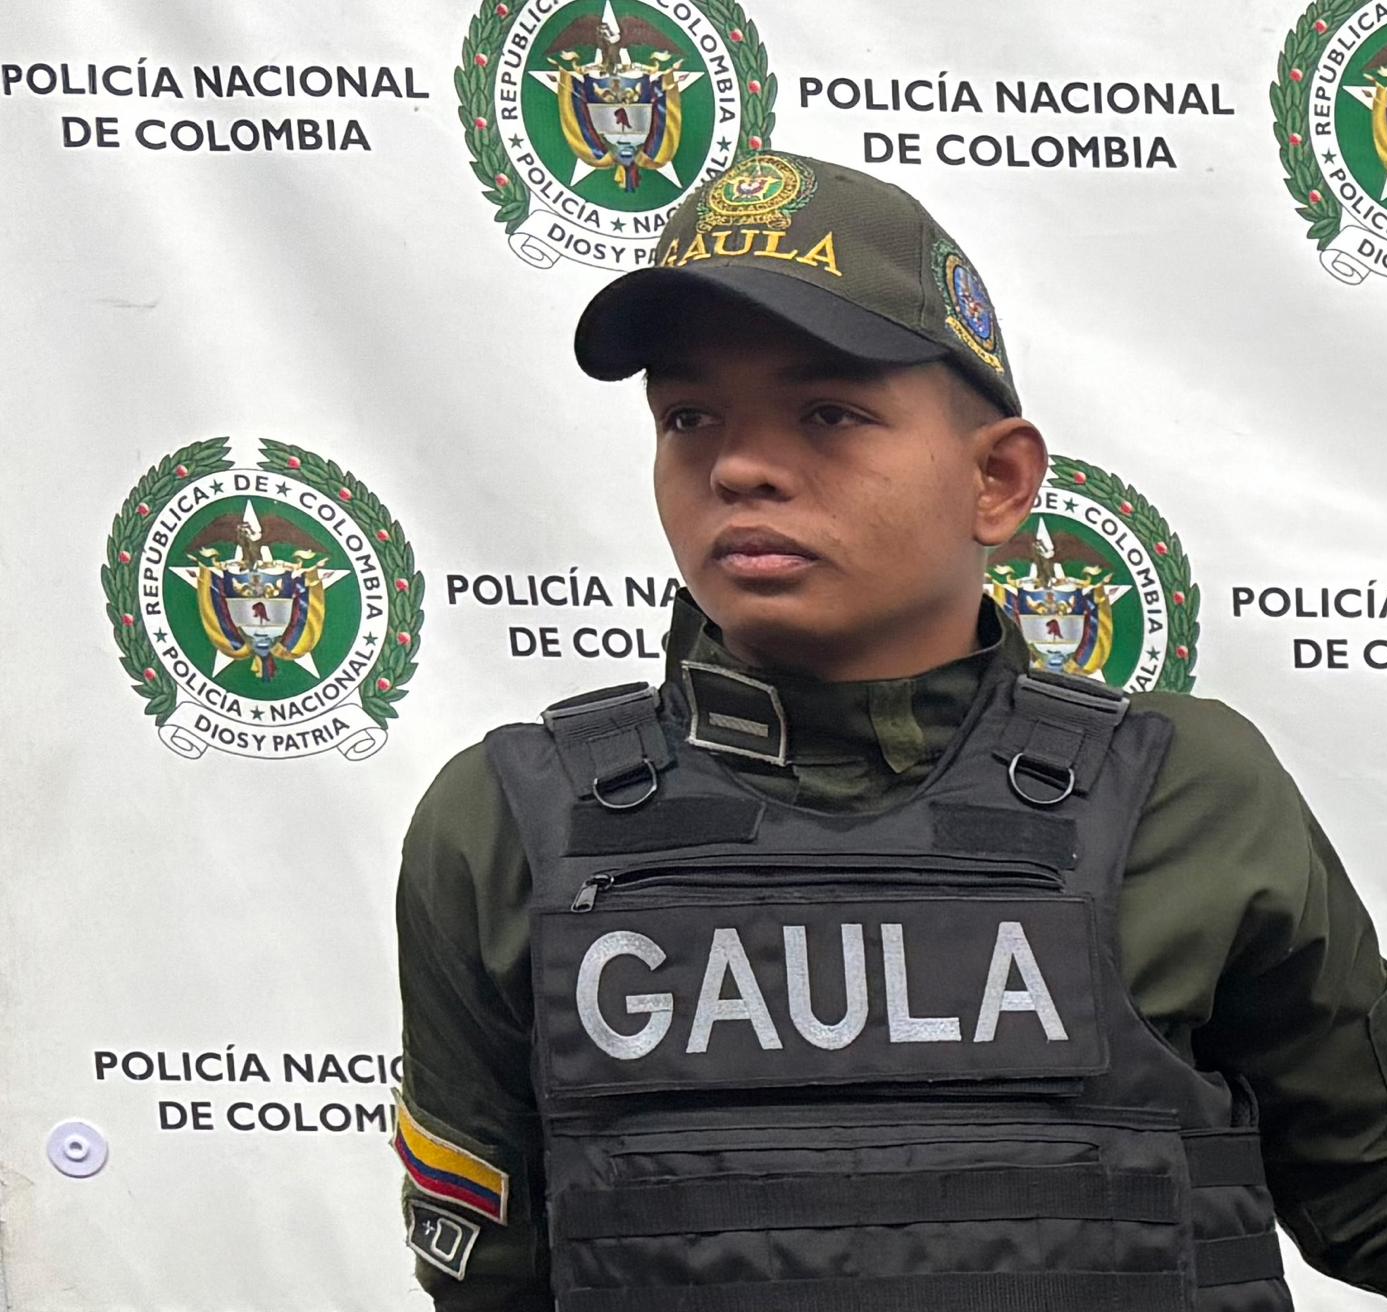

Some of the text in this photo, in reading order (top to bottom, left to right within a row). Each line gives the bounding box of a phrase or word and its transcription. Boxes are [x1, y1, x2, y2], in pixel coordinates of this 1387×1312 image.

[2, 58, 429, 98] POLICÍA NACIONAL
[800, 71, 1234, 114] POLICÍA NACIONAL
[62, 117, 371, 151] DE COLOMBIA
[864, 133, 1176, 168] DE COLOMBIA
[233, 474, 265, 492] DE
[299, 491, 383, 620] COLOMBIA
[447, 567, 612, 606] POLICÍA
[509, 627, 561, 657] DE
[1294, 639, 1348, 668] DE
[270, 650, 374, 721] NACIONAL
[273, 718, 350, 752] PATRIA
[575, 920, 1070, 1061] GAULA
[95, 1043, 270, 1082] POLICÍA
[159, 1102, 396, 1132] DE COLOM
